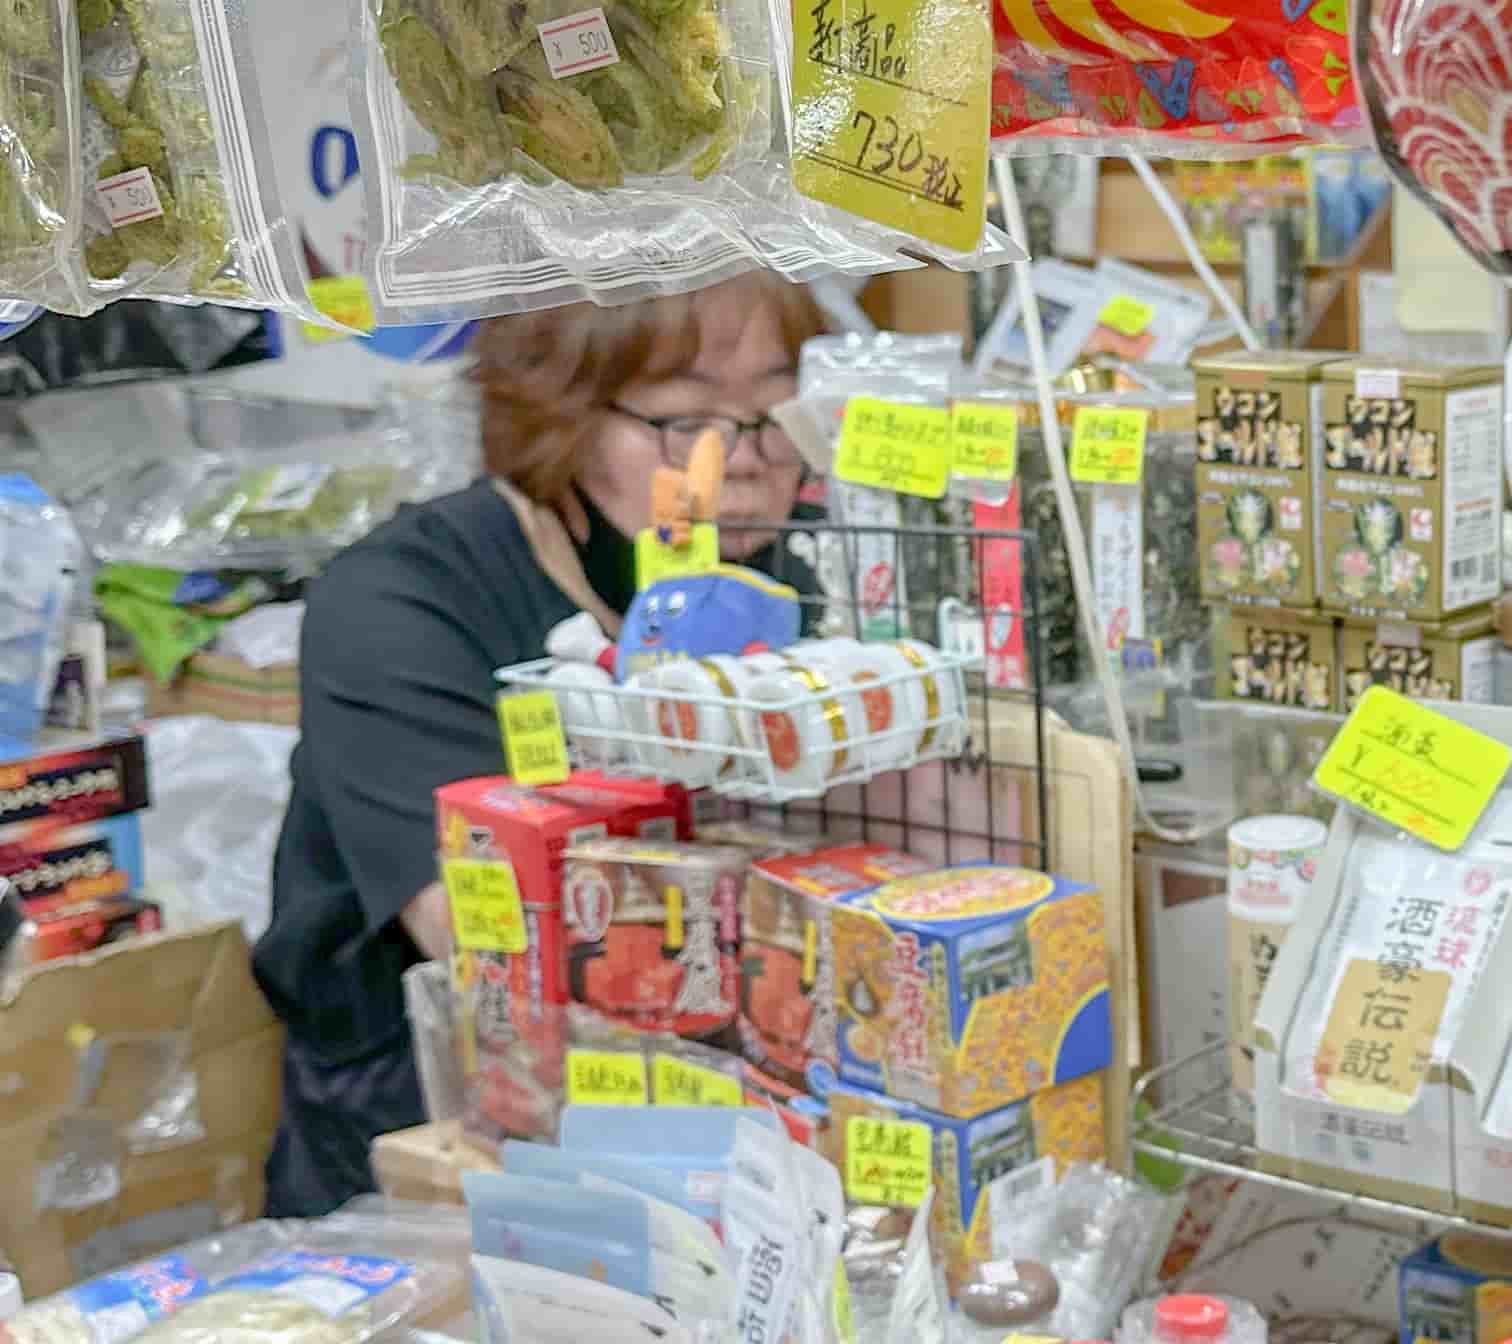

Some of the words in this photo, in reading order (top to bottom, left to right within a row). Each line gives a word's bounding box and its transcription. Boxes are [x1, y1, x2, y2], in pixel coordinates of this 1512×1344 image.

[579, 30, 609, 56] 500
[852, 110, 925, 176] 730
[921, 156, 963, 207] 税込
[1339, 894, 1445, 1090] 酒豪伝説
